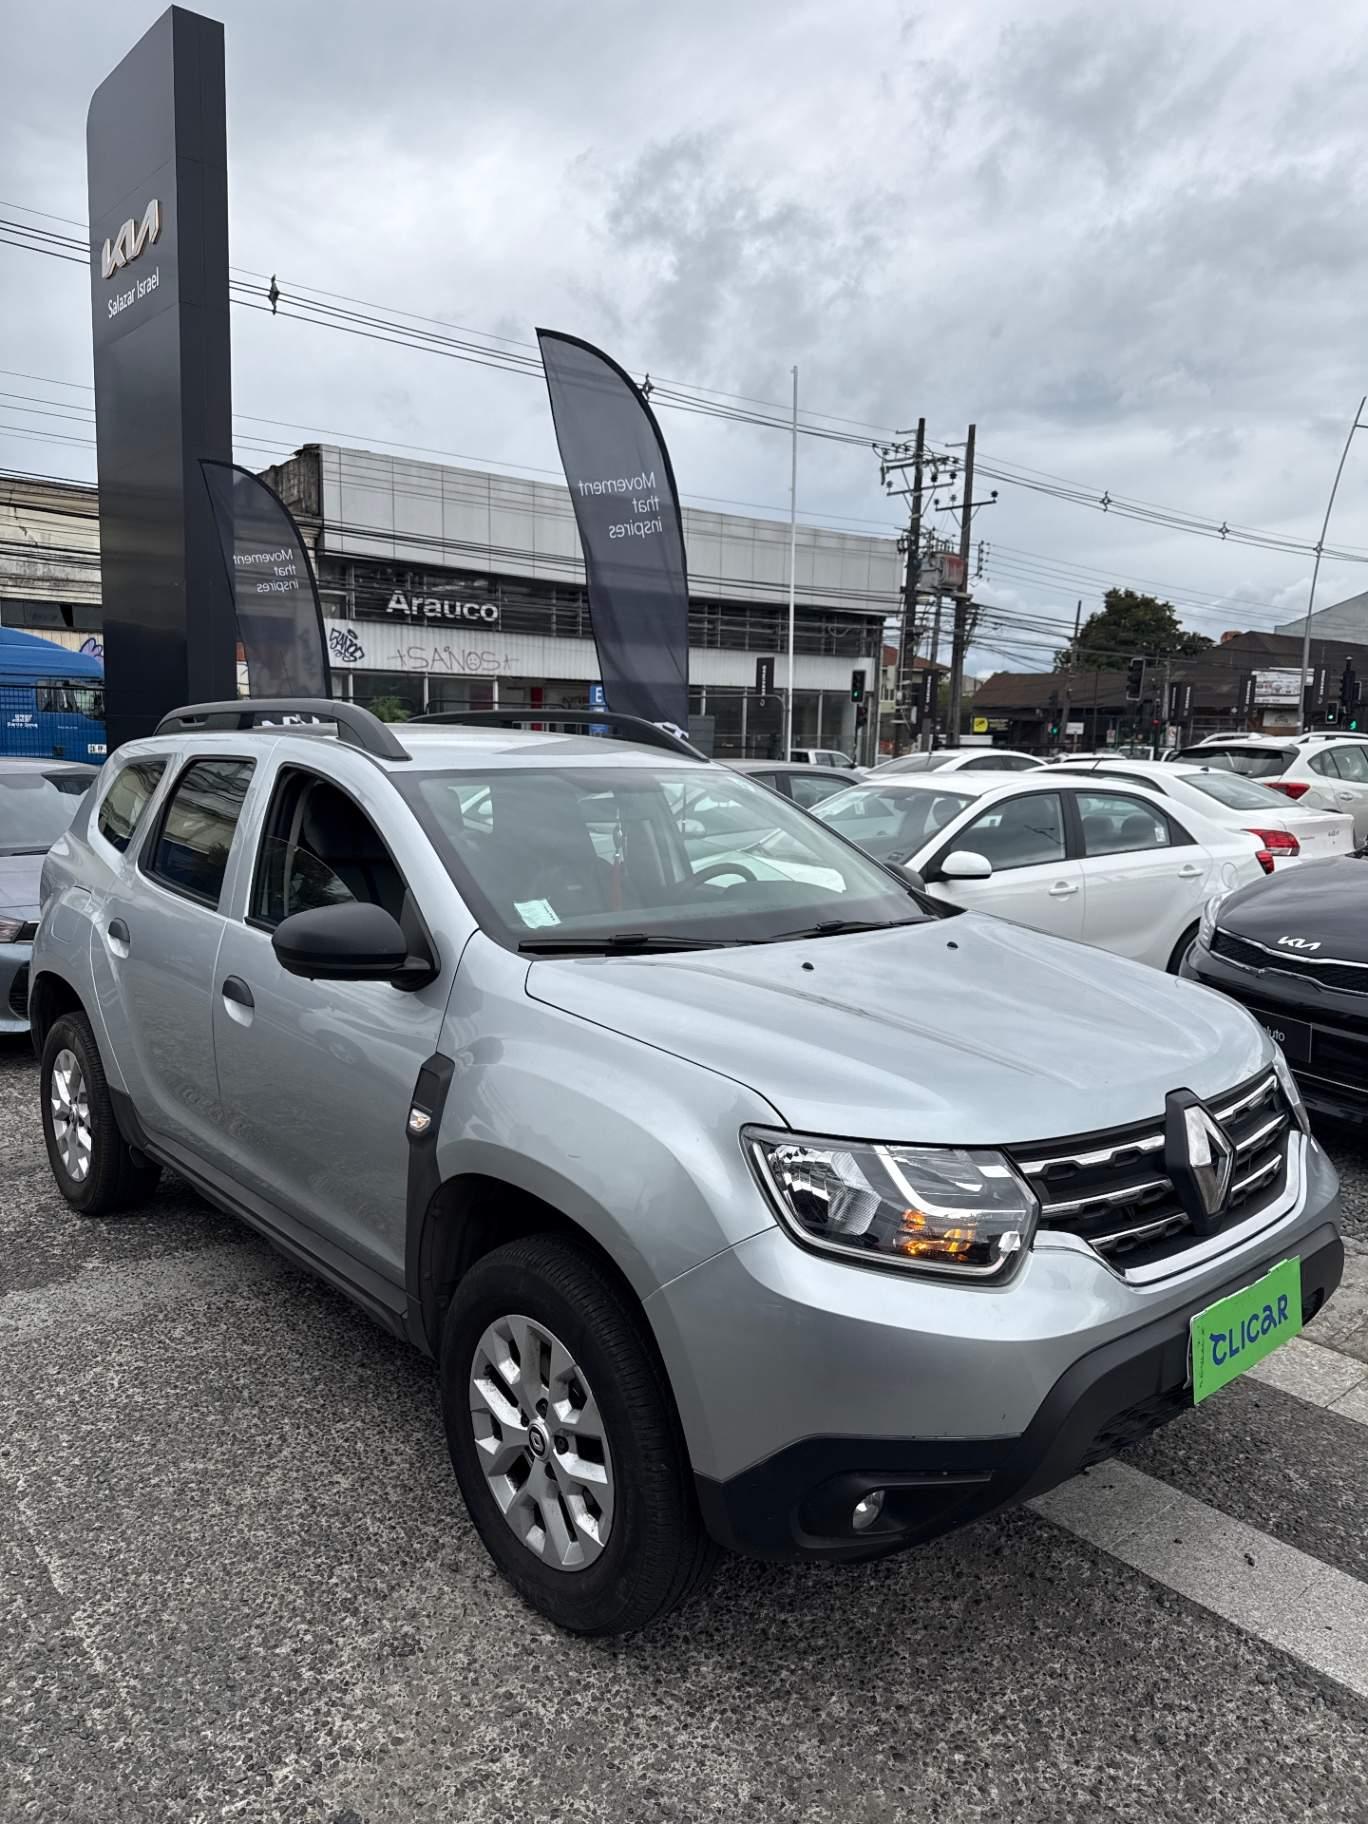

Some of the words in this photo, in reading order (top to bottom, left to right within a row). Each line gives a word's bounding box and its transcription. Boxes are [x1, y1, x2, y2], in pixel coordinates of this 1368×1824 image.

[101, 199, 160, 279] KIA
[107, 287, 136, 318] Salazar
[136, 266, 160, 299] Israel
[386, 589, 499, 622] Arauco
[1277, 935, 1321, 951] KIA
